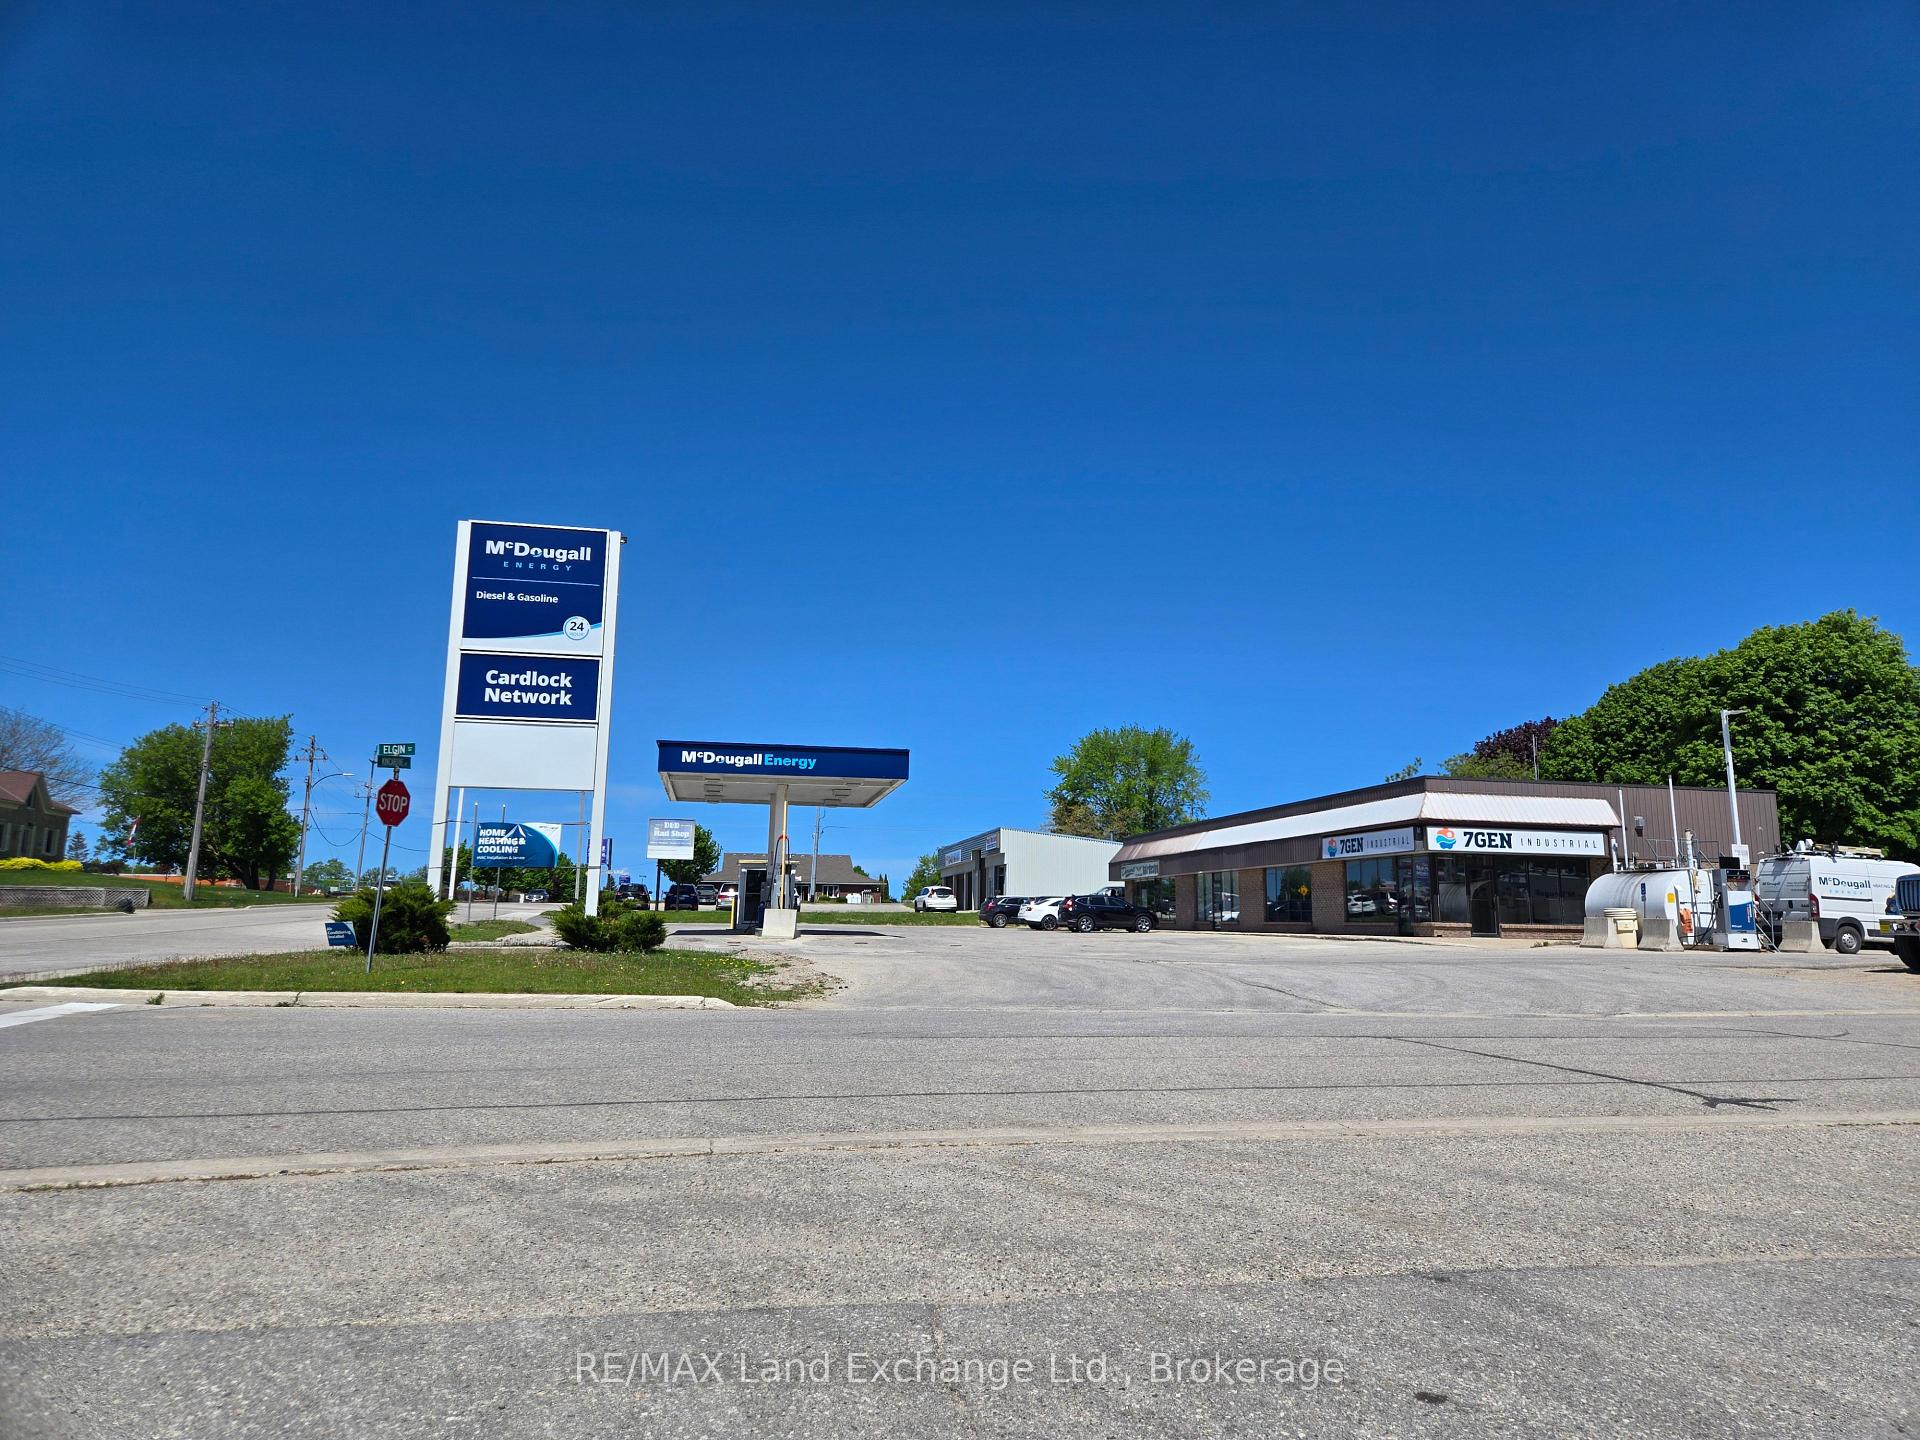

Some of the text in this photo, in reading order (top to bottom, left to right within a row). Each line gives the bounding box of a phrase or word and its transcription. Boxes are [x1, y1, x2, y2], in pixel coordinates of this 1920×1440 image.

[485, 540, 591, 562] McDougall
[503, 561, 572, 572] ENERGY
[476, 590, 559, 603] Diesel & Gasoline
[569, 621, 585, 631] 24
[485, 669, 573, 688] Cardlock
[484, 687, 572, 706] Network
[383, 744, 406, 755] ELGIN
[681, 750, 817, 770] McDougall Energy
[379, 793, 408, 813] STOP
[479, 828, 507, 837] HOME
[478, 837, 526, 846] HEATING &
[1339, 836, 1410, 854] 7GEN INDUSTRIAL
[1463, 831, 1597, 849] 7GEN INDUSTRIAL
[477, 845, 519, 854] COOLING
[1818, 876, 1871, 889] McDougall
